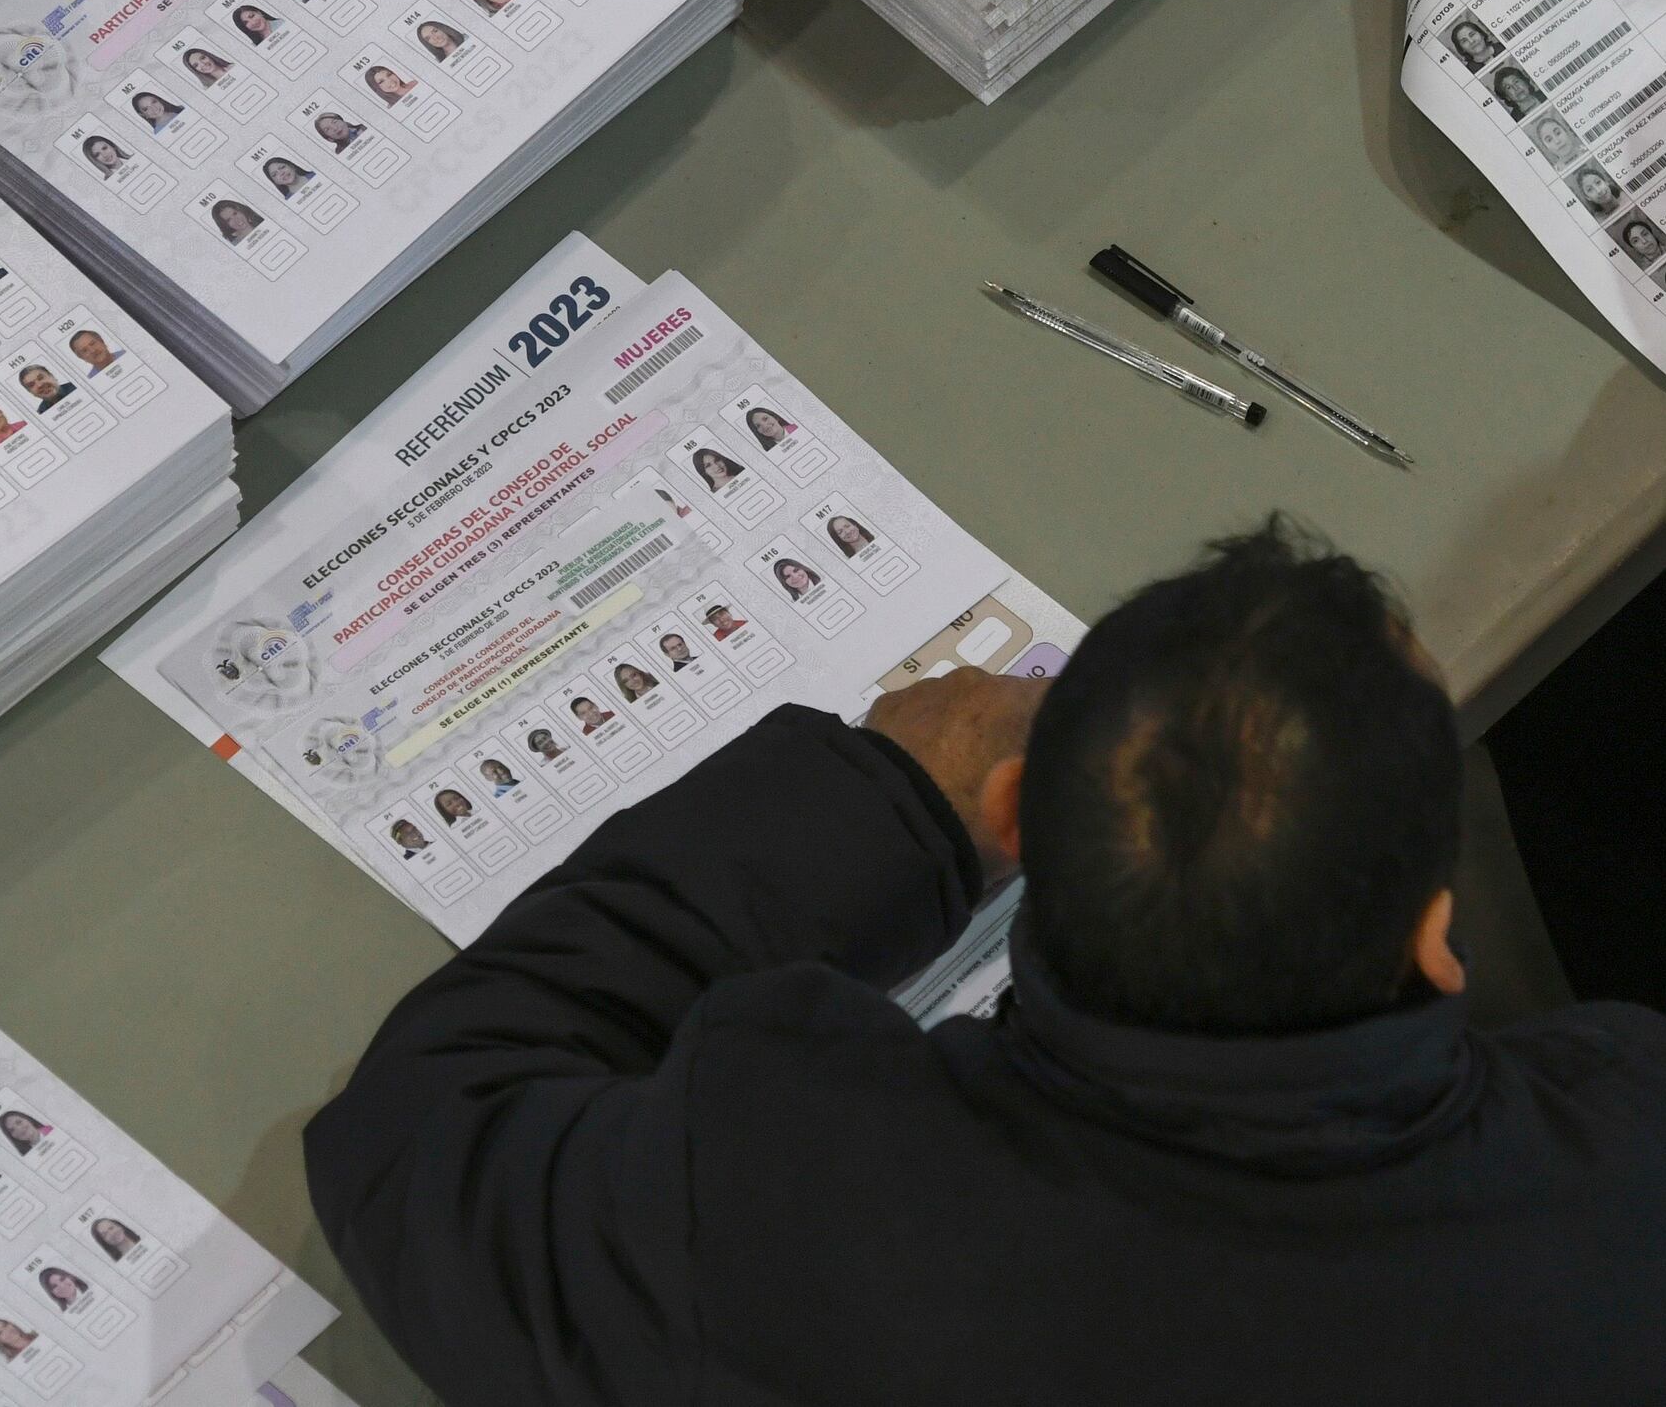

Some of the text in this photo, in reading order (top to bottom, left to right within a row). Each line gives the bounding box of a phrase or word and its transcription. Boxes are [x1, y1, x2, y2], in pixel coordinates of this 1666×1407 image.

[1431, 1, 1454, 25] FOTOS
[171, 40, 185, 51] M3
[352, 56, 370, 71] M13
[71, 127, 85, 139] M1
[198, 192, 216, 207] M10
[57, 319, 75, 333] H20
[613, 307, 692, 369] MUJERES
[394, 275, 610, 466] REFERÉNDUM 2023
[302, 384, 571, 589] ELECCIONES SECCIONALES Y CPCCS 2023
[377, 441, 572, 591] CONSEJERAS DEL CONSEJO DE
[332, 566, 434, 644] PARTICIPACION
[432, 506, 515, 568] CIUDADANA
[510, 495, 524, 506] Y
[524, 450, 589, 498] CONTROL
[586, 413, 637, 451] SOCIAL
[439, 621, 589, 728] SE ELIGE UN (1) REPRESENTANTE
[902, 657, 923, 675] SI
